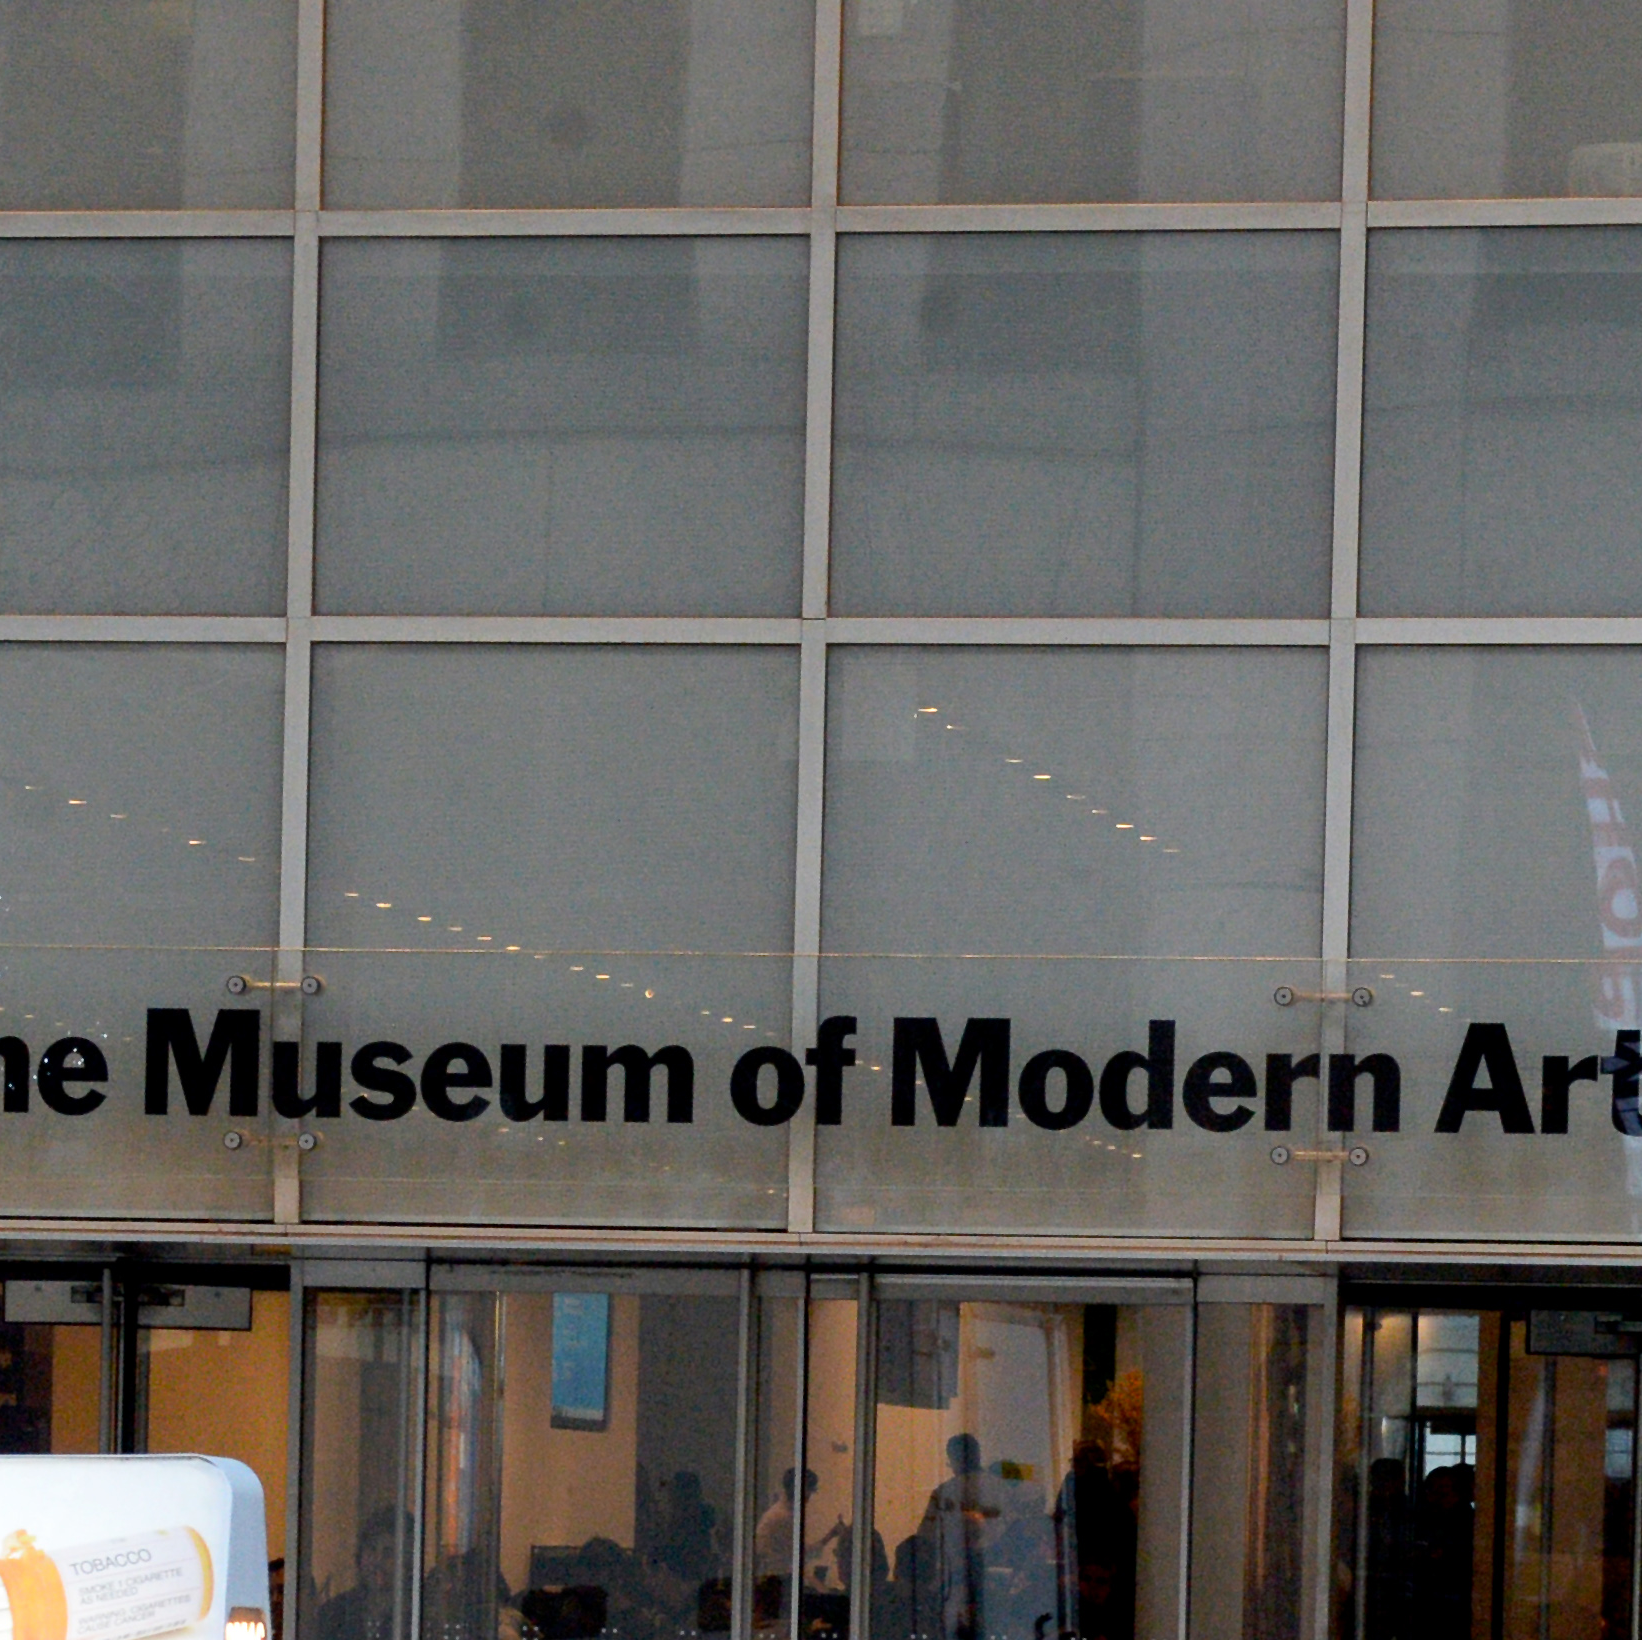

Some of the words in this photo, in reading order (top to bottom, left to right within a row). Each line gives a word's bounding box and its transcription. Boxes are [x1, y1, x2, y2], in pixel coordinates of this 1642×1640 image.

[143, 1006, 694, 1124] Museum
[729, 1014, 857, 1126] of
[891, 1017, 1401, 1133] Modern
[69, 1548, 152, 1576] TOBACCO
